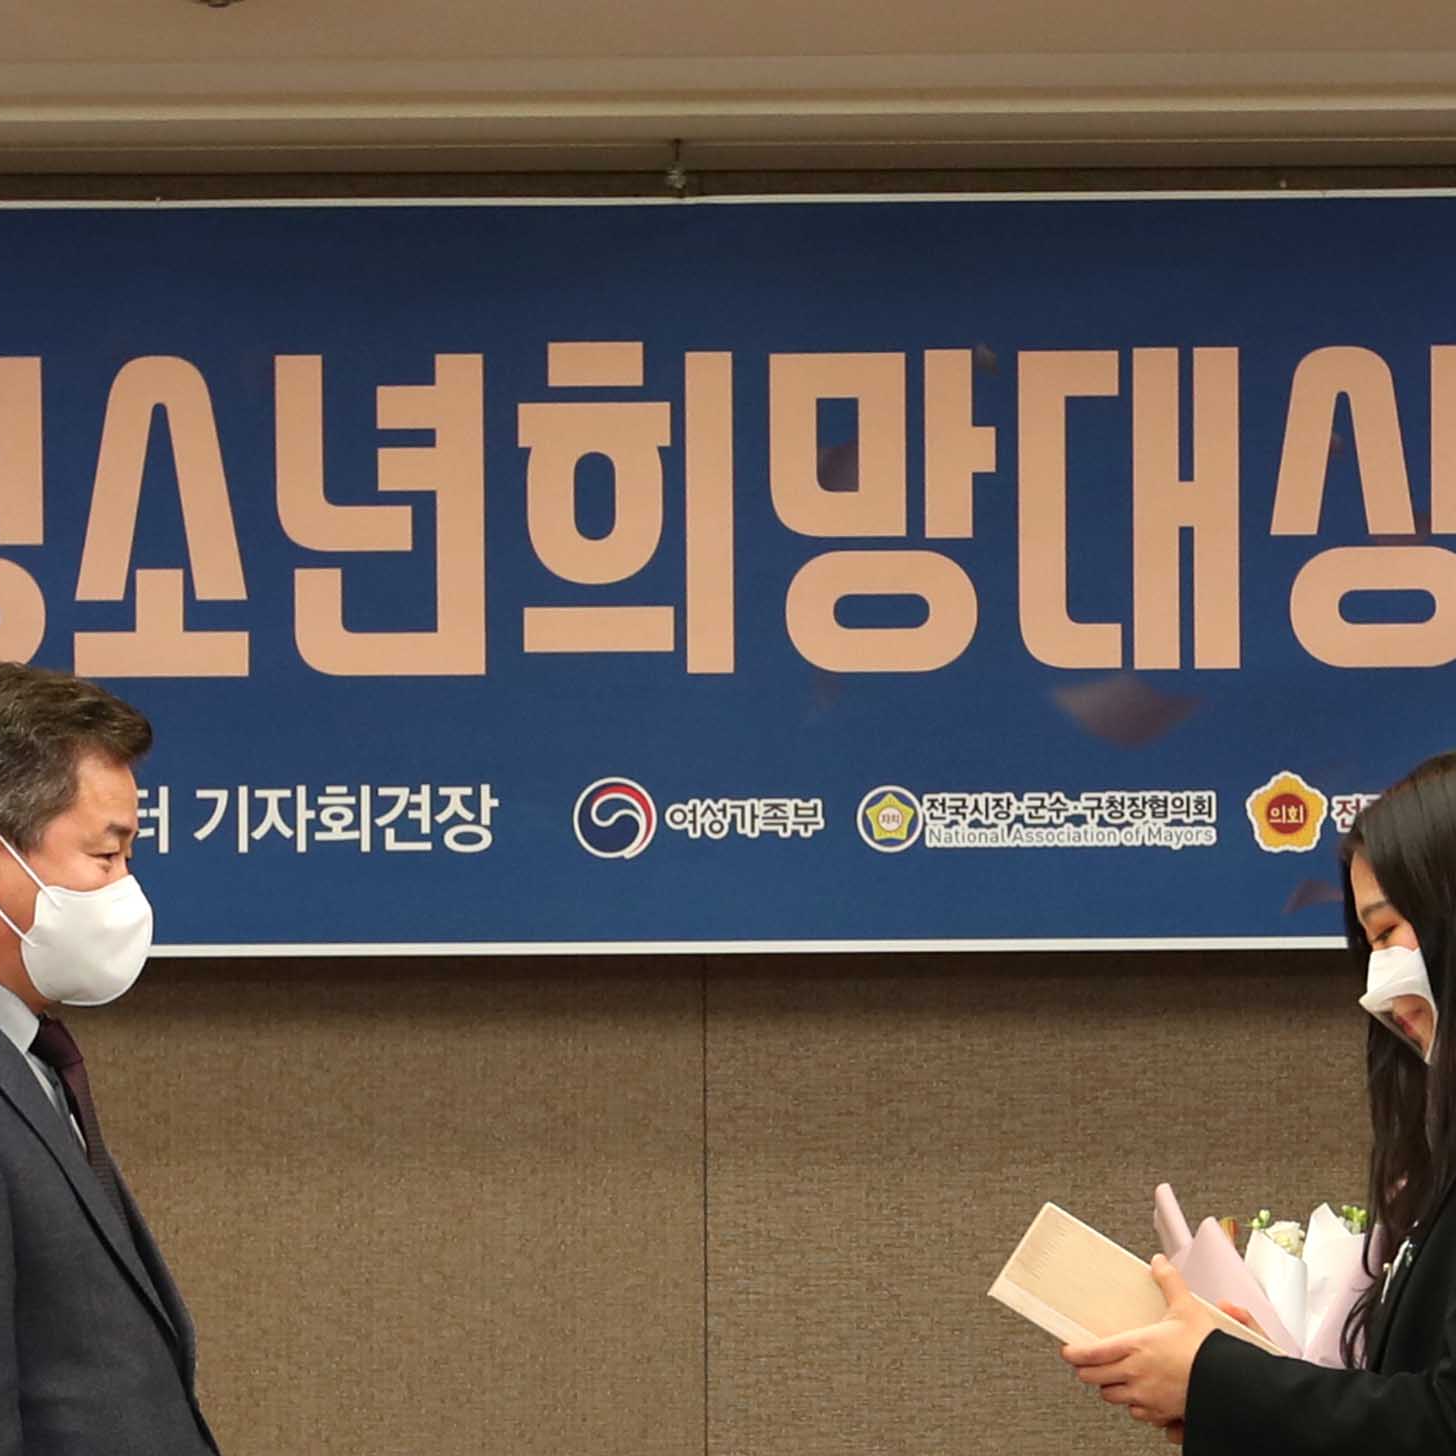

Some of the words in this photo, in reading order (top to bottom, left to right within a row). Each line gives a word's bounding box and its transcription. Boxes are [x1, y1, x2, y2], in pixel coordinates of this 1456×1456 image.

[193, 783, 499, 853] 기자회견장
[668, 802, 821, 836] 여성가족부
[1269, 804, 1304, 824] 의회
[928, 827, 1005, 843] National
[1012, 826, 1117, 843] Association
[1123, 826, 1141, 843] of
[1147, 826, 1214, 846] Mayors
